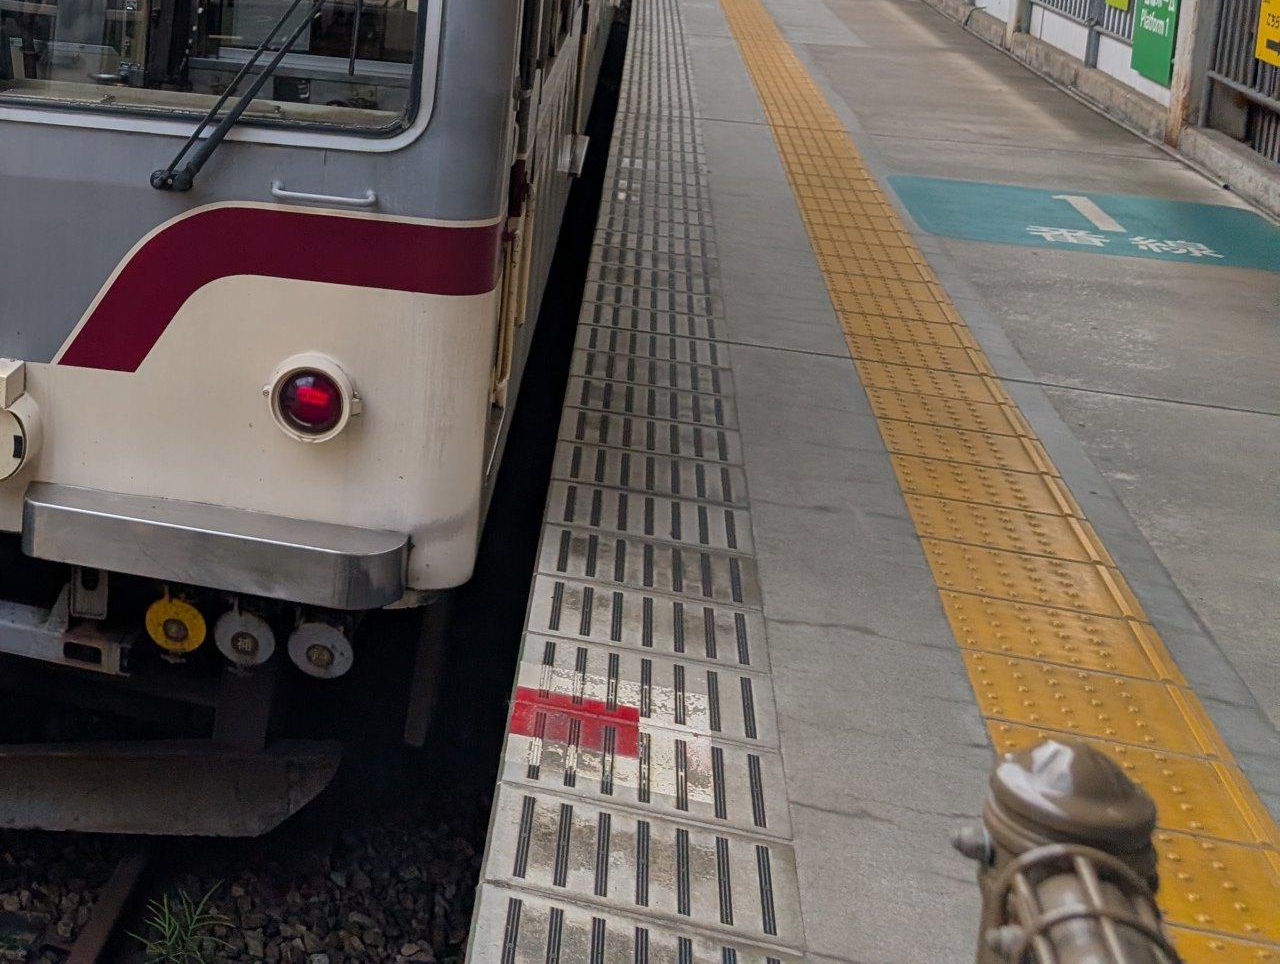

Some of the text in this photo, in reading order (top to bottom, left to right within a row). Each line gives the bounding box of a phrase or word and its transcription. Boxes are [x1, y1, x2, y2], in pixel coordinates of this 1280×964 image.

[1139, 8, 1165, 36] Platform
[1051, 194, 1128, 233] 1
[1025, 225, 1225, 258] 番線
